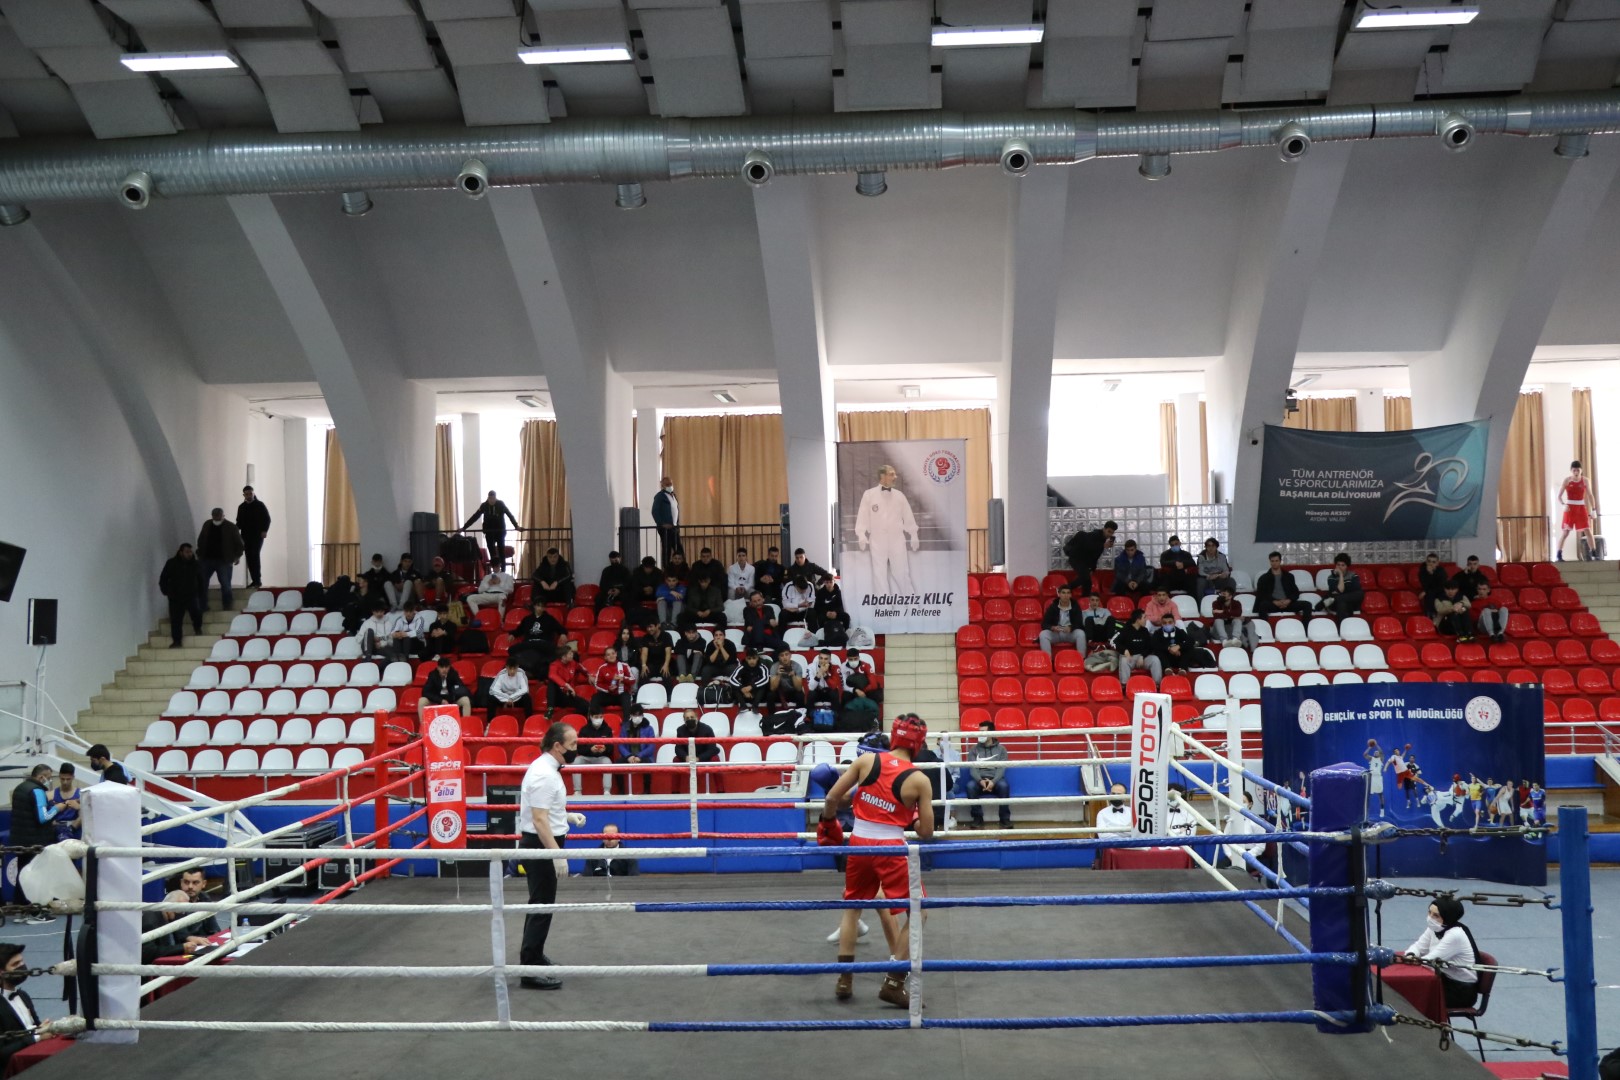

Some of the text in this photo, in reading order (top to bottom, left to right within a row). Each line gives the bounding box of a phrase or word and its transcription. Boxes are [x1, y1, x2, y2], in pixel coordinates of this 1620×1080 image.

[1291, 468, 1374, 479] TÜM ANTRENÖR
[1279, 478, 1384, 488] VE SPORCULARIMIZA
[1280, 490, 1381, 499] BAŞARILAR DİLİYORUM
[862, 592, 954, 607] Abdulaziz KILIÇ
[874, 609, 901, 617] Hakem
[911, 608, 941, 617] Referee
[1373, 699, 1405, 708] AYDIN
[1324, 707, 1463, 723] GENÇLİK ve SPOR İL MÜDÜRLÜĞÜ
[430, 760, 462, 769] SPOR
[1138, 700, 1157, 835] SPOR TOTO
[437, 786, 455, 797] aiba
[860, 791, 896, 813] SAMSUN
